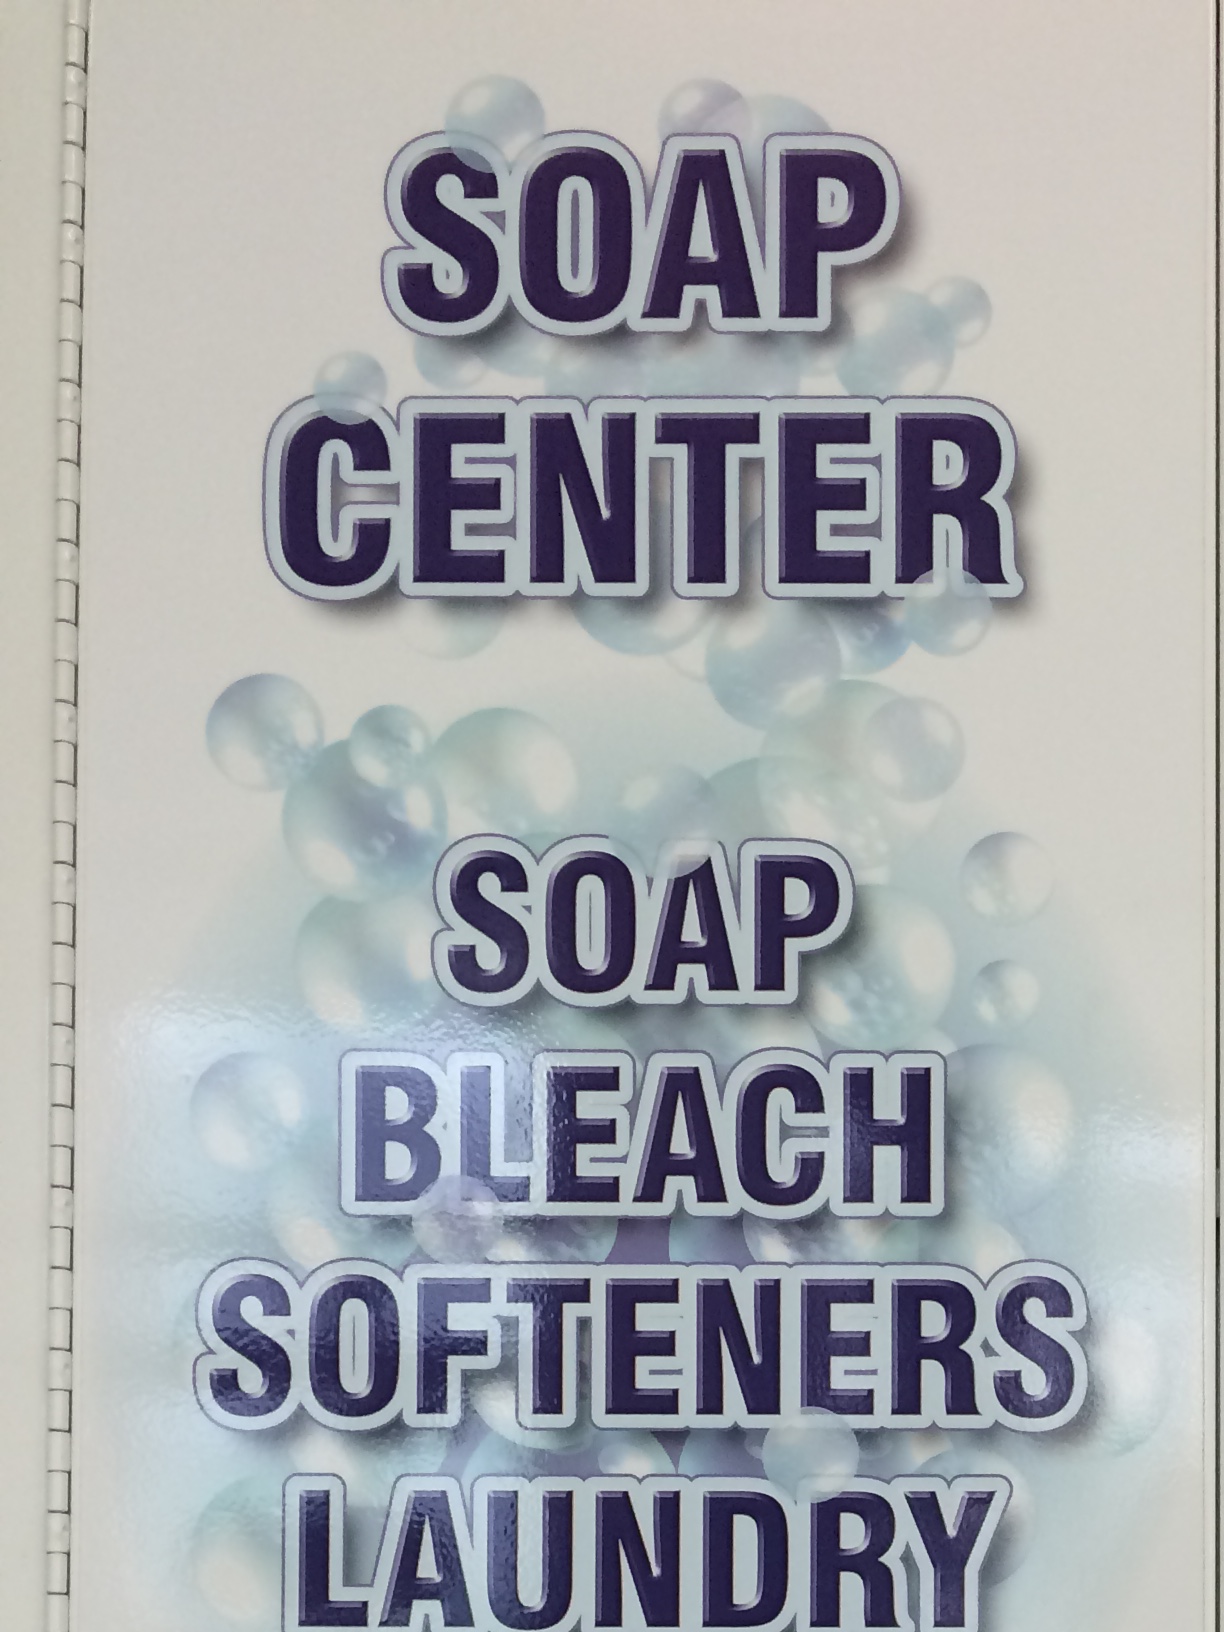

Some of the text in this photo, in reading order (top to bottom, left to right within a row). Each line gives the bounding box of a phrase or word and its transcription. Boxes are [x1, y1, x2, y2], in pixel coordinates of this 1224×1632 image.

[392, 140, 895, 330] SOAP
[272, 404, 1017, 592] CENTER
[440, 842, 846, 998] SOAP
[347, 1058, 937, 1210] BLEACH
[202, 1266, 1082, 1423] SOFTENERS
